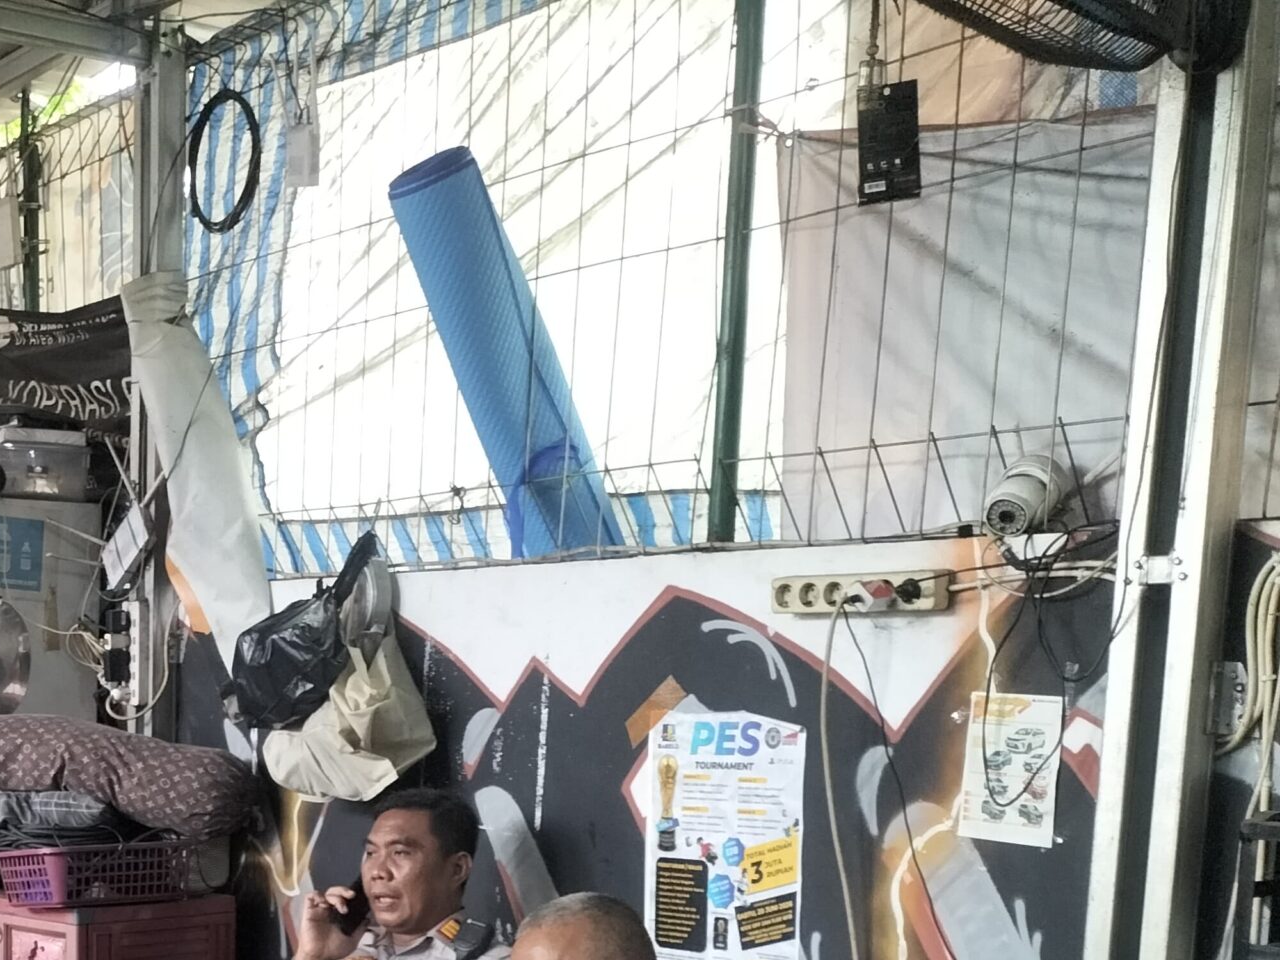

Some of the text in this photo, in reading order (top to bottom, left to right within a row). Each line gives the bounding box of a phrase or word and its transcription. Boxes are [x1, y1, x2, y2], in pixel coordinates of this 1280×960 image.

[689, 721, 762, 757] PES
[695, 761, 754, 771] TOURNAMENT
[751, 860, 763, 884] 3
